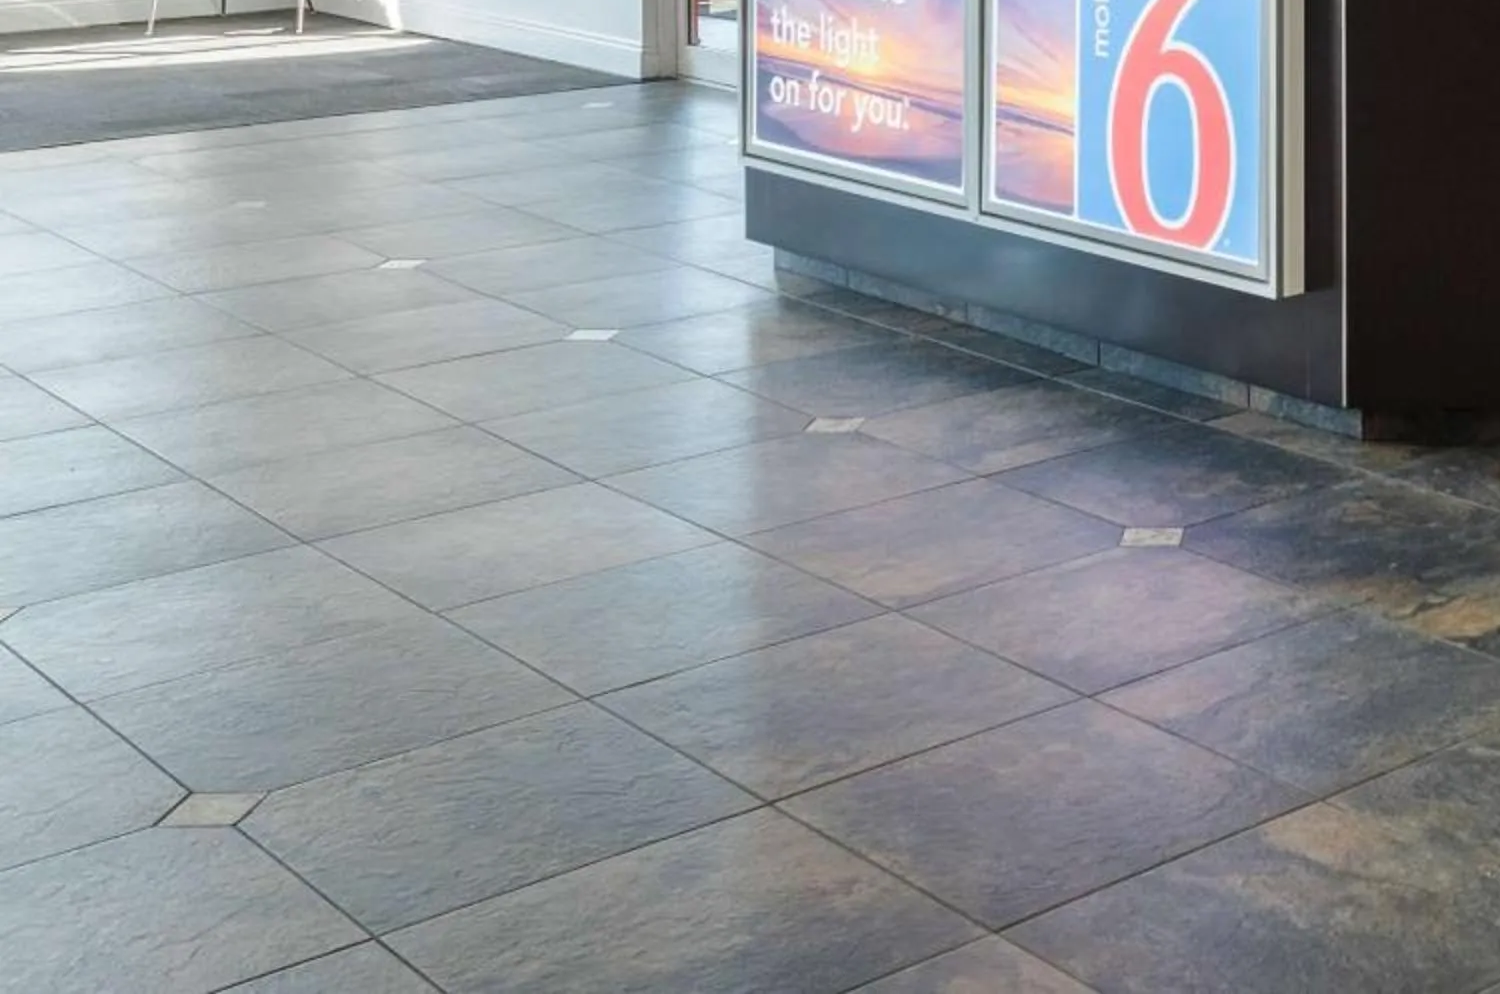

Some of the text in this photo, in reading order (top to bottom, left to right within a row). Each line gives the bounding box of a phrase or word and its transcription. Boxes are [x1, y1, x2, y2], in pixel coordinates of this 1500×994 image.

[770, 6, 880, 67] the light
[769, 74, 800, 106] on
[808, 70, 847, 116] for
